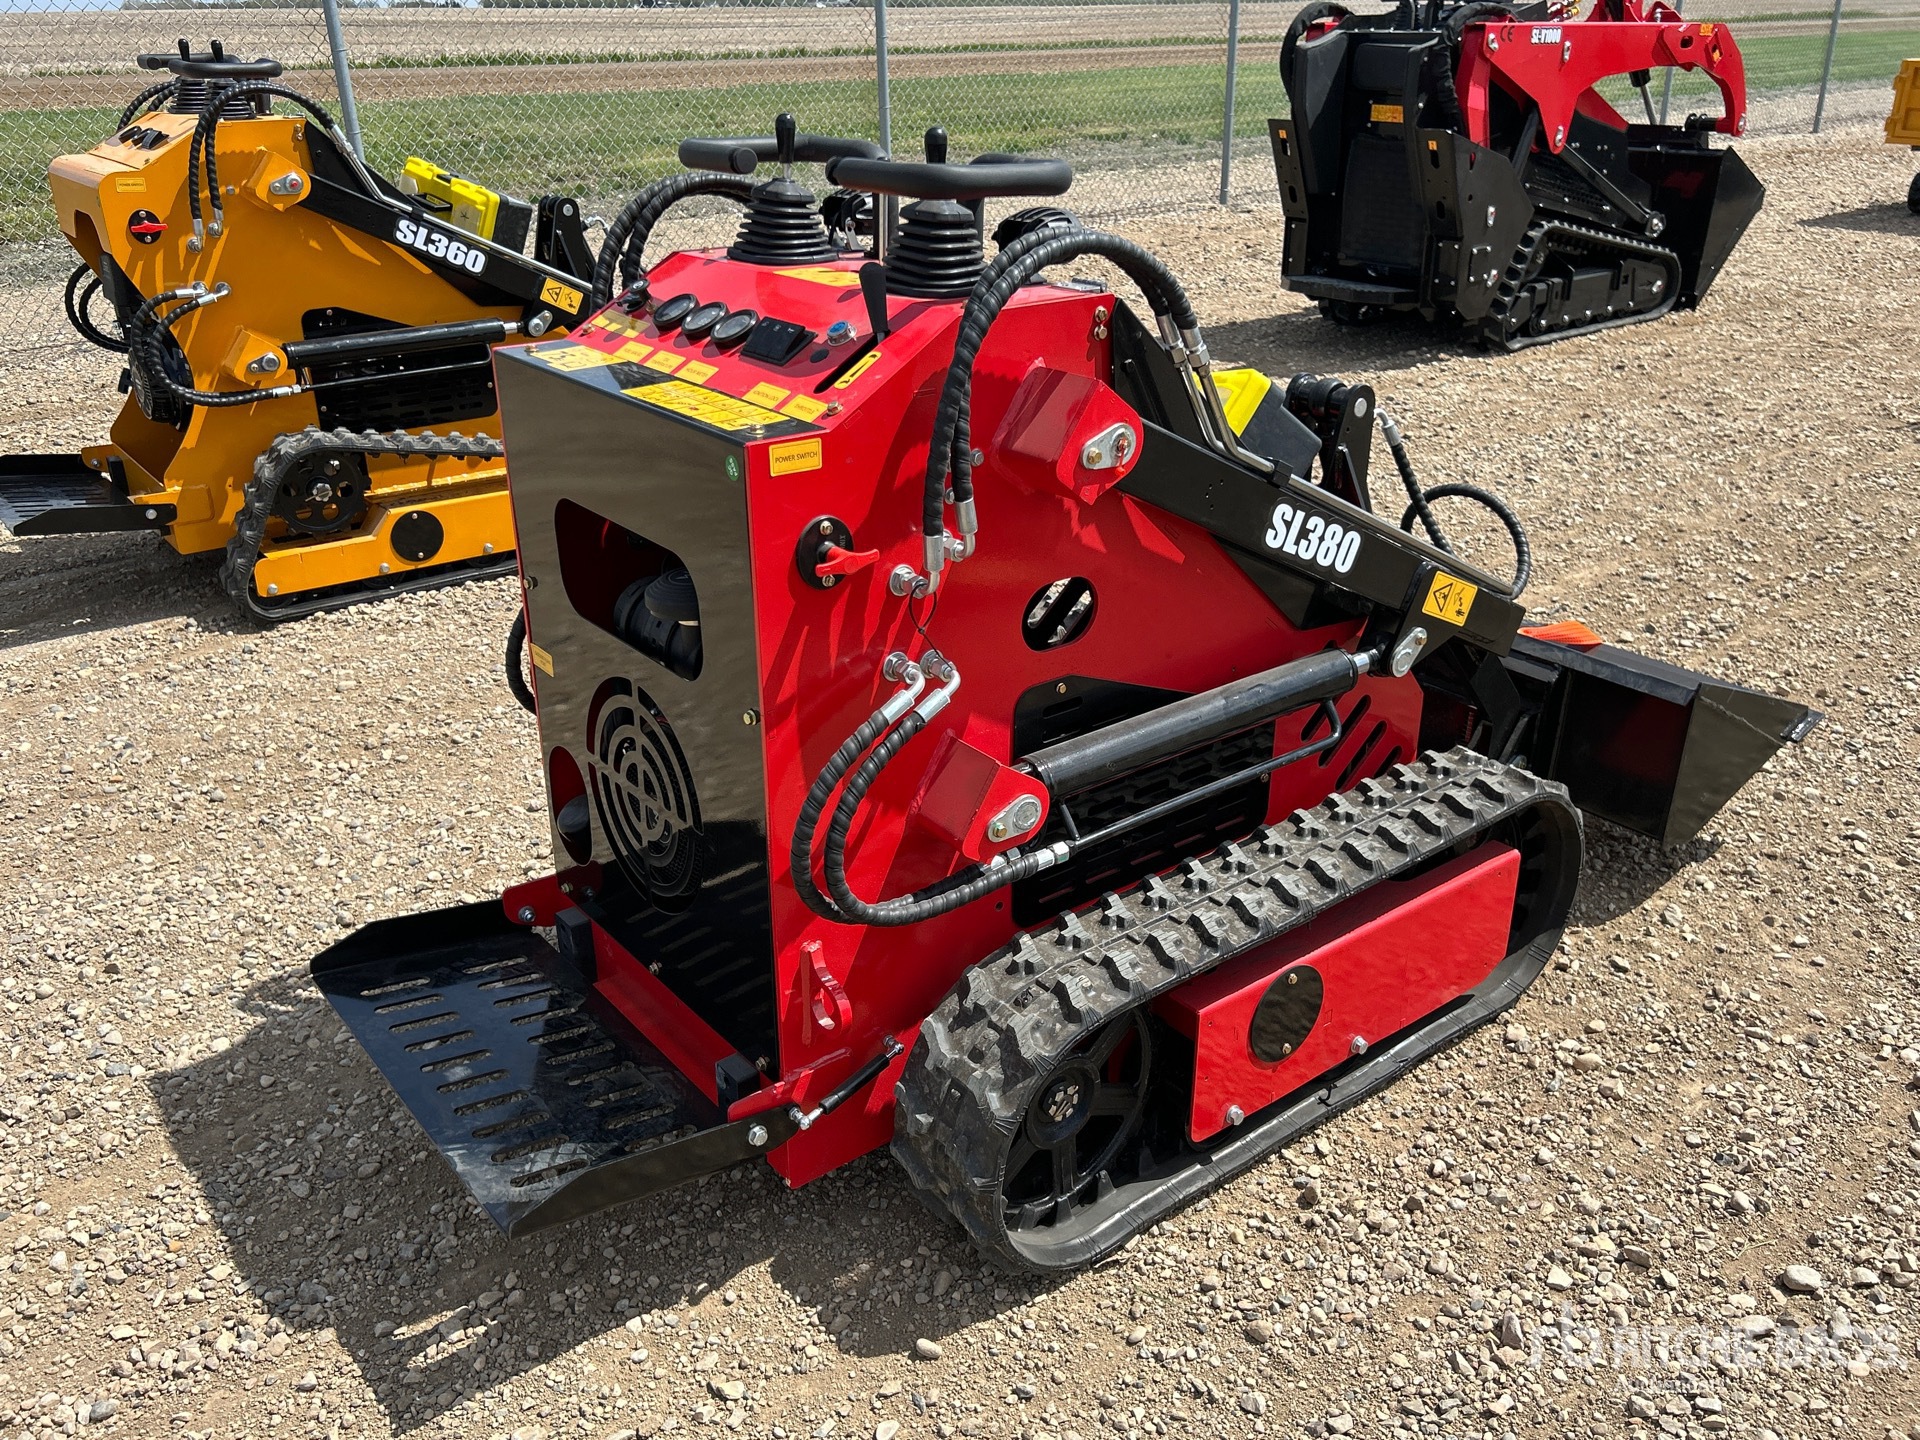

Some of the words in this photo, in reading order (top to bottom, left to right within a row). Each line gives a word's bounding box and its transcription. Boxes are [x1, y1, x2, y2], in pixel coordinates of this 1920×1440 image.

[395, 219, 486, 273] SL360
[774, 455, 796, 464] POWER
[796, 451, 818, 461] SWITCH
[1265, 503, 1362, 574] SL380
